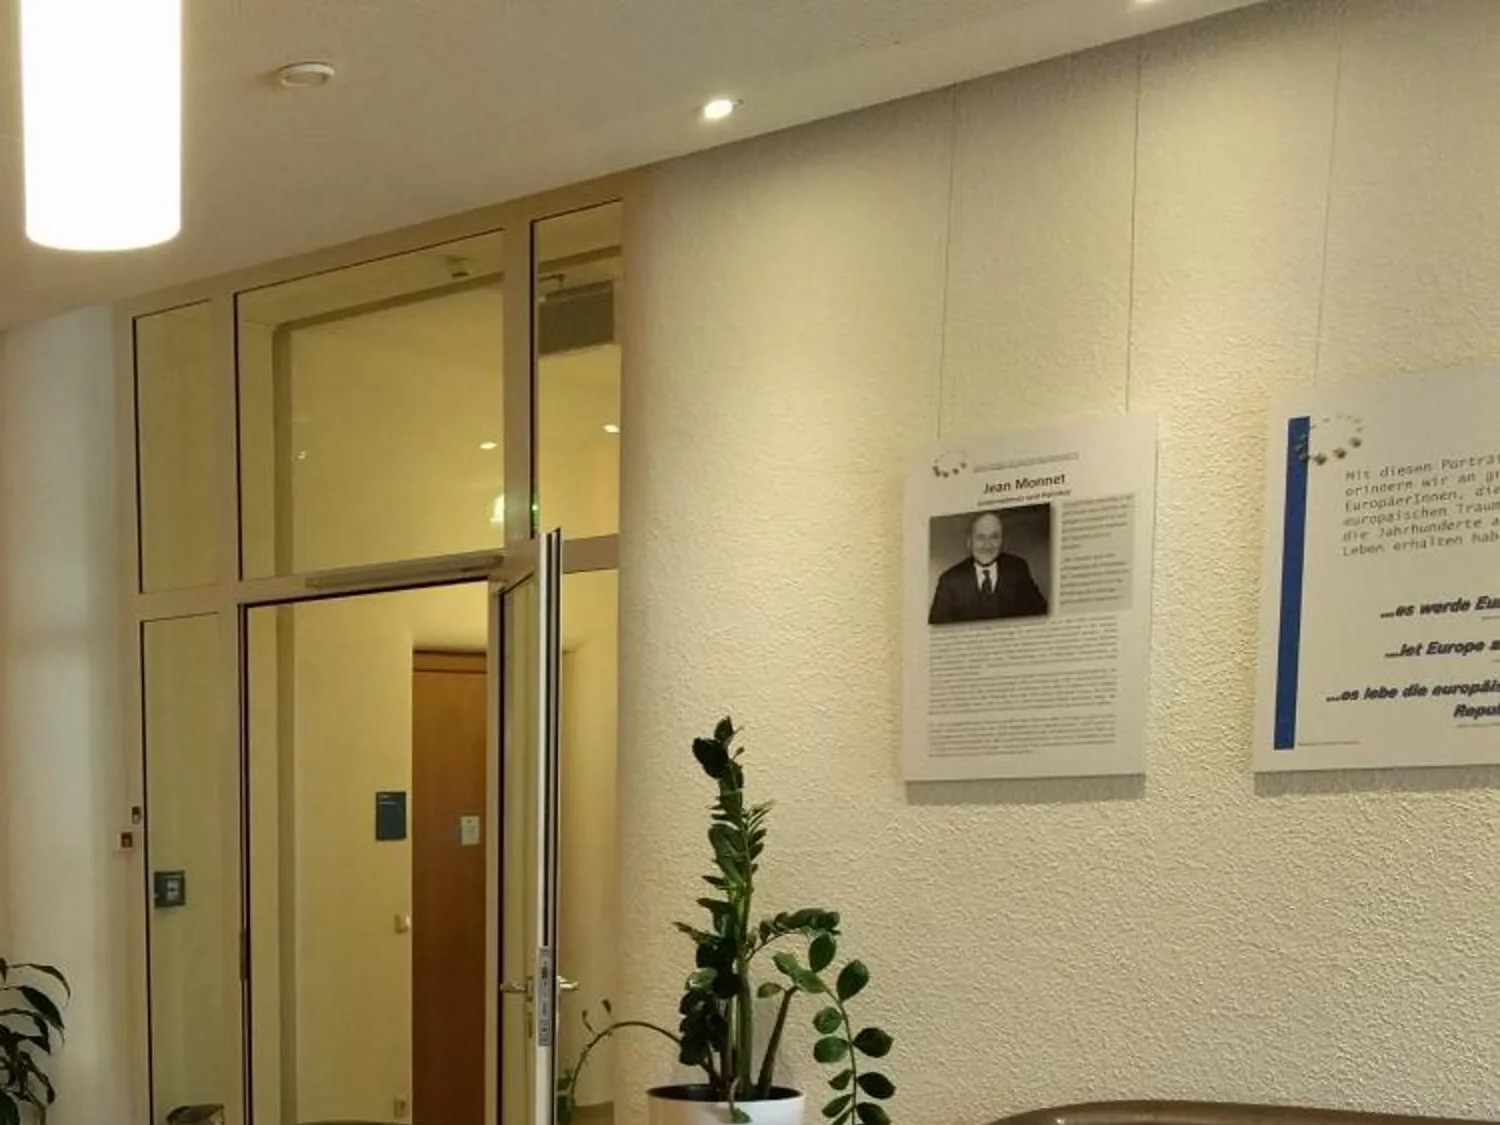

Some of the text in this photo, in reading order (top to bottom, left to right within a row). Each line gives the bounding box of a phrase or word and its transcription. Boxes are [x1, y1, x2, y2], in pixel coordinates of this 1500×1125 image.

[983, 473, 1066, 495] Jean Monnet
[1420, 597, 1471, 614] werde
[1426, 641, 1484, 656] Europe
[1363, 686, 1398, 700] lebe
[1402, 682, 1428, 698] die
